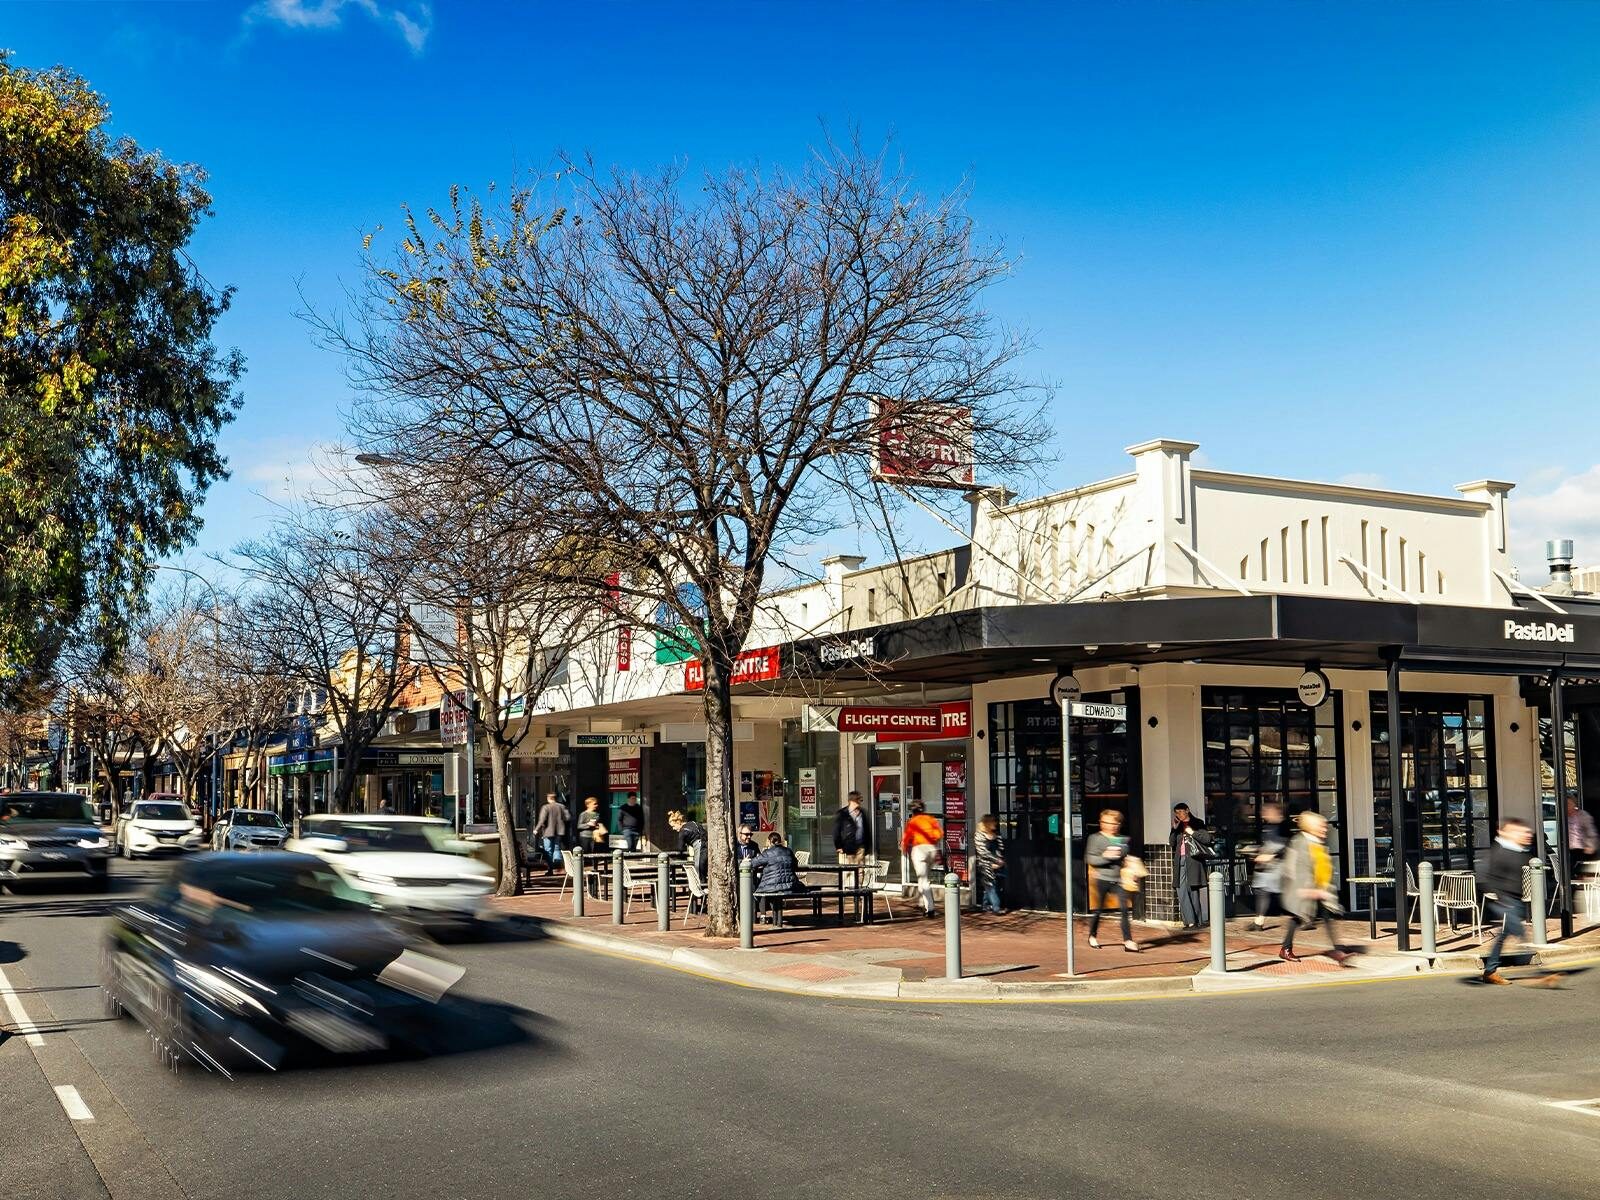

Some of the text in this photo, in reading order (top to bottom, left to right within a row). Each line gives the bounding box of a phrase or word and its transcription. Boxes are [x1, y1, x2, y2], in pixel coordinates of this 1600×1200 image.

[1504, 619, 1575, 643] PastaDeli
[820, 636, 874, 662] PastaDeli
[731, 655, 770, 676] ENTRE
[1085, 705, 1116, 718] EDWARD
[845, 714, 937, 726] FLIGHT CENTRE
[944, 712, 967, 727] TRE
[607, 734, 648, 745] OPTICAL
[409, 755, 445, 764] JO MERC
[803, 787, 813, 795] FOR
